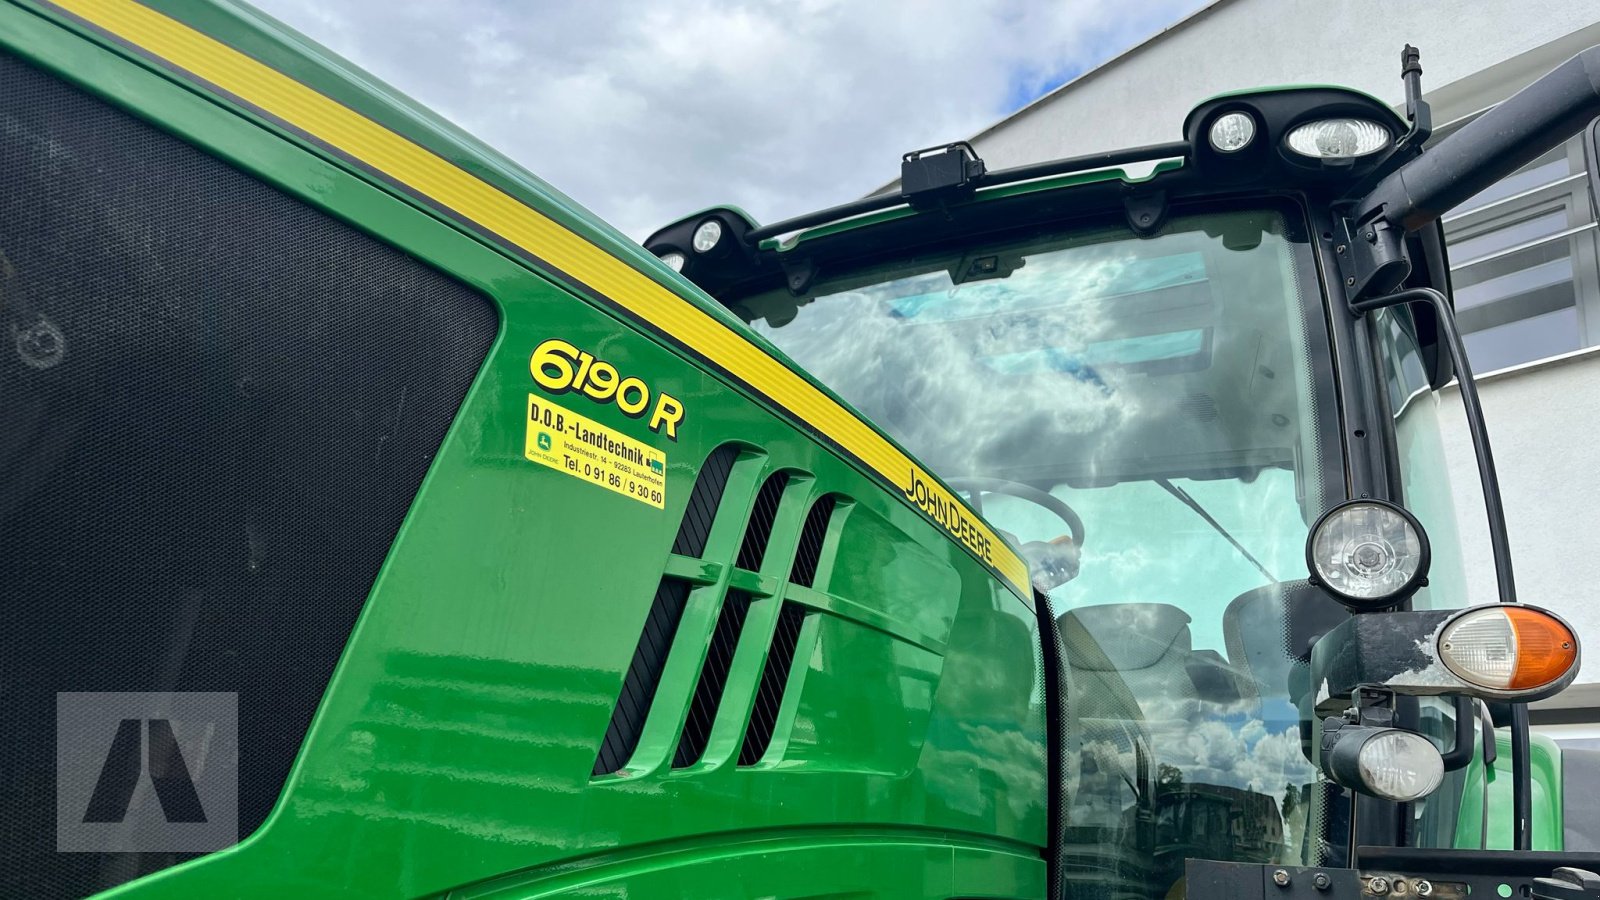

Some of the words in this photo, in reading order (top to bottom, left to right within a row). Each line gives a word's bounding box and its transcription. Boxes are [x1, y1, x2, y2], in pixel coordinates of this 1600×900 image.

[529, 338, 650, 419] 6190
[648, 392, 686, 442] R
[531, 403, 644, 466] D.O.B.-Landtechnik
[563, 454, 581, 473] Tel.
[584, 463, 591, 476] 0
[593, 467, 605, 482] 91
[608, 473, 621, 488] 86
[629, 481, 635, 493] 9
[637, 484, 649, 499] 30
[651, 490, 662, 504] 60
[564, 441, 599, 461] Industriestr.
[601, 456, 607, 464] 14
[613, 461, 632, 474] 92283
[632, 468, 663, 486] Lauterhofen
